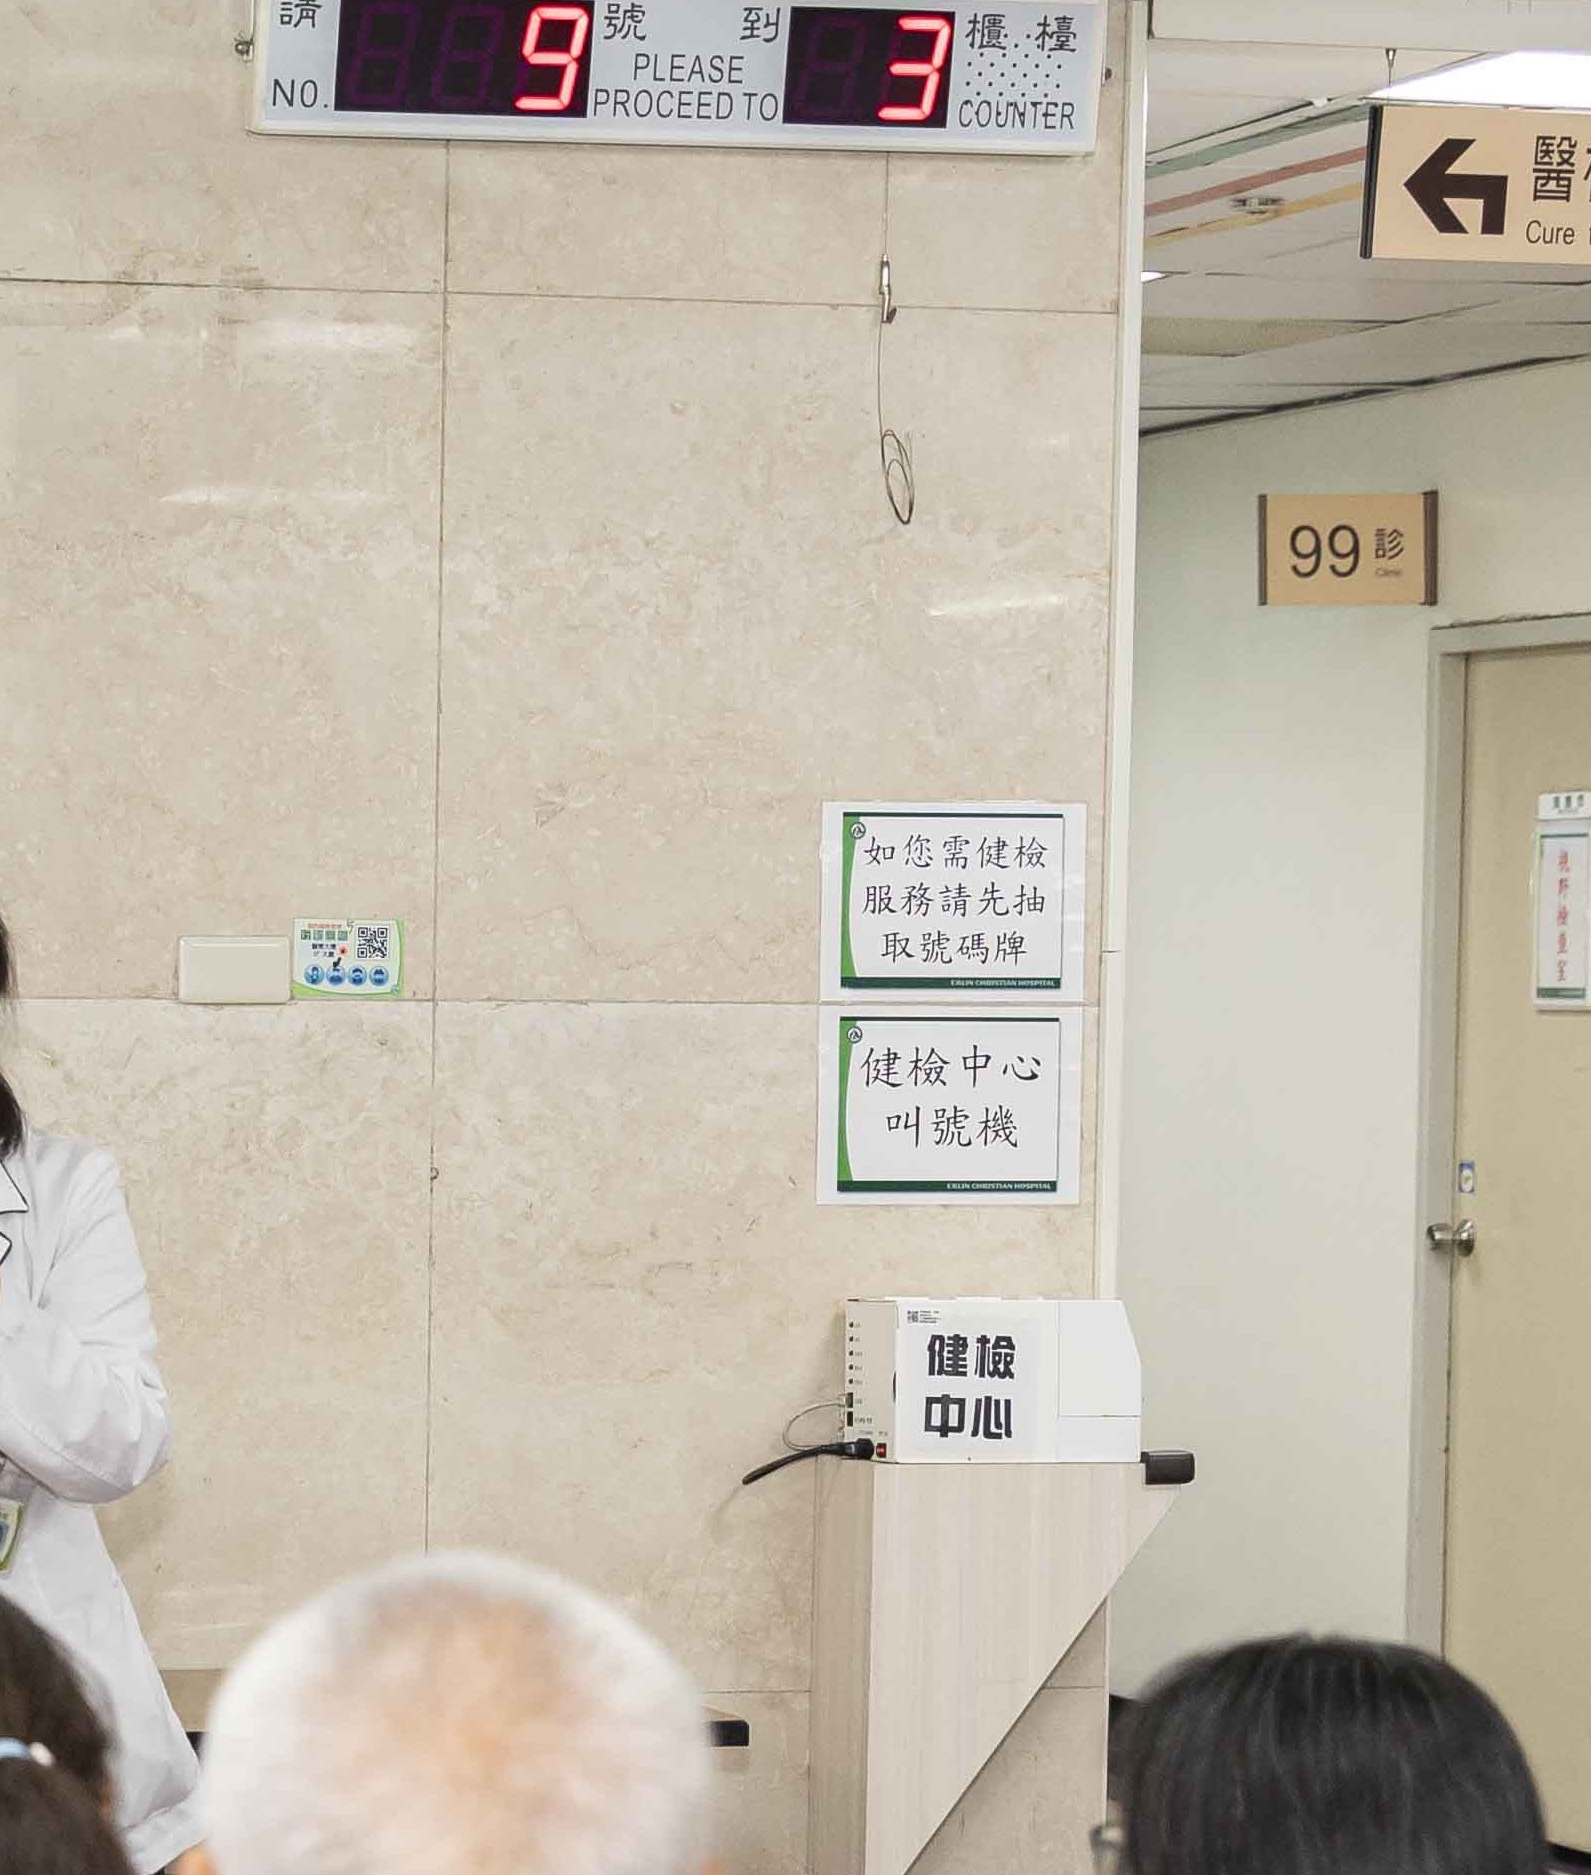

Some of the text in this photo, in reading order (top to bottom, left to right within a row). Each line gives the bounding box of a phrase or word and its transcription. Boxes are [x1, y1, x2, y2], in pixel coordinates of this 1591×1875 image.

[603, 3, 647, 39] 號
[740, 5, 780, 44] 到
[514, 5, 589, 112] 9
[632, 54, 745, 84] PLEASE
[876, 15, 953, 121] 3
[272, 77, 329, 109] NO.
[593, 88, 780, 123] PROCEED TO
[957, 98, 1076, 132] COUNTER
[1525, 219, 1579, 247] Cure
[1290, 525, 1404, 578] 99 診
[863, 834, 1049, 870] 如您需健檢
[861, 882, 1045, 917] 服務請先抽
[880, 930, 1027, 966] 取號碼牌
[950, 979, 1056, 988] ERLIN CHRISTIAN HOSPITAL
[860, 1045, 1043, 1088] 健檢中心
[885, 1104, 1019, 1149] 叫號機
[971, 1183, 1013, 1191] CHRISTIAN
[1014, 1183, 1052, 1192] HOSPITAL
[926, 1333, 1016, 1380] 健檢
[924, 1393, 1012, 1440] 中心
